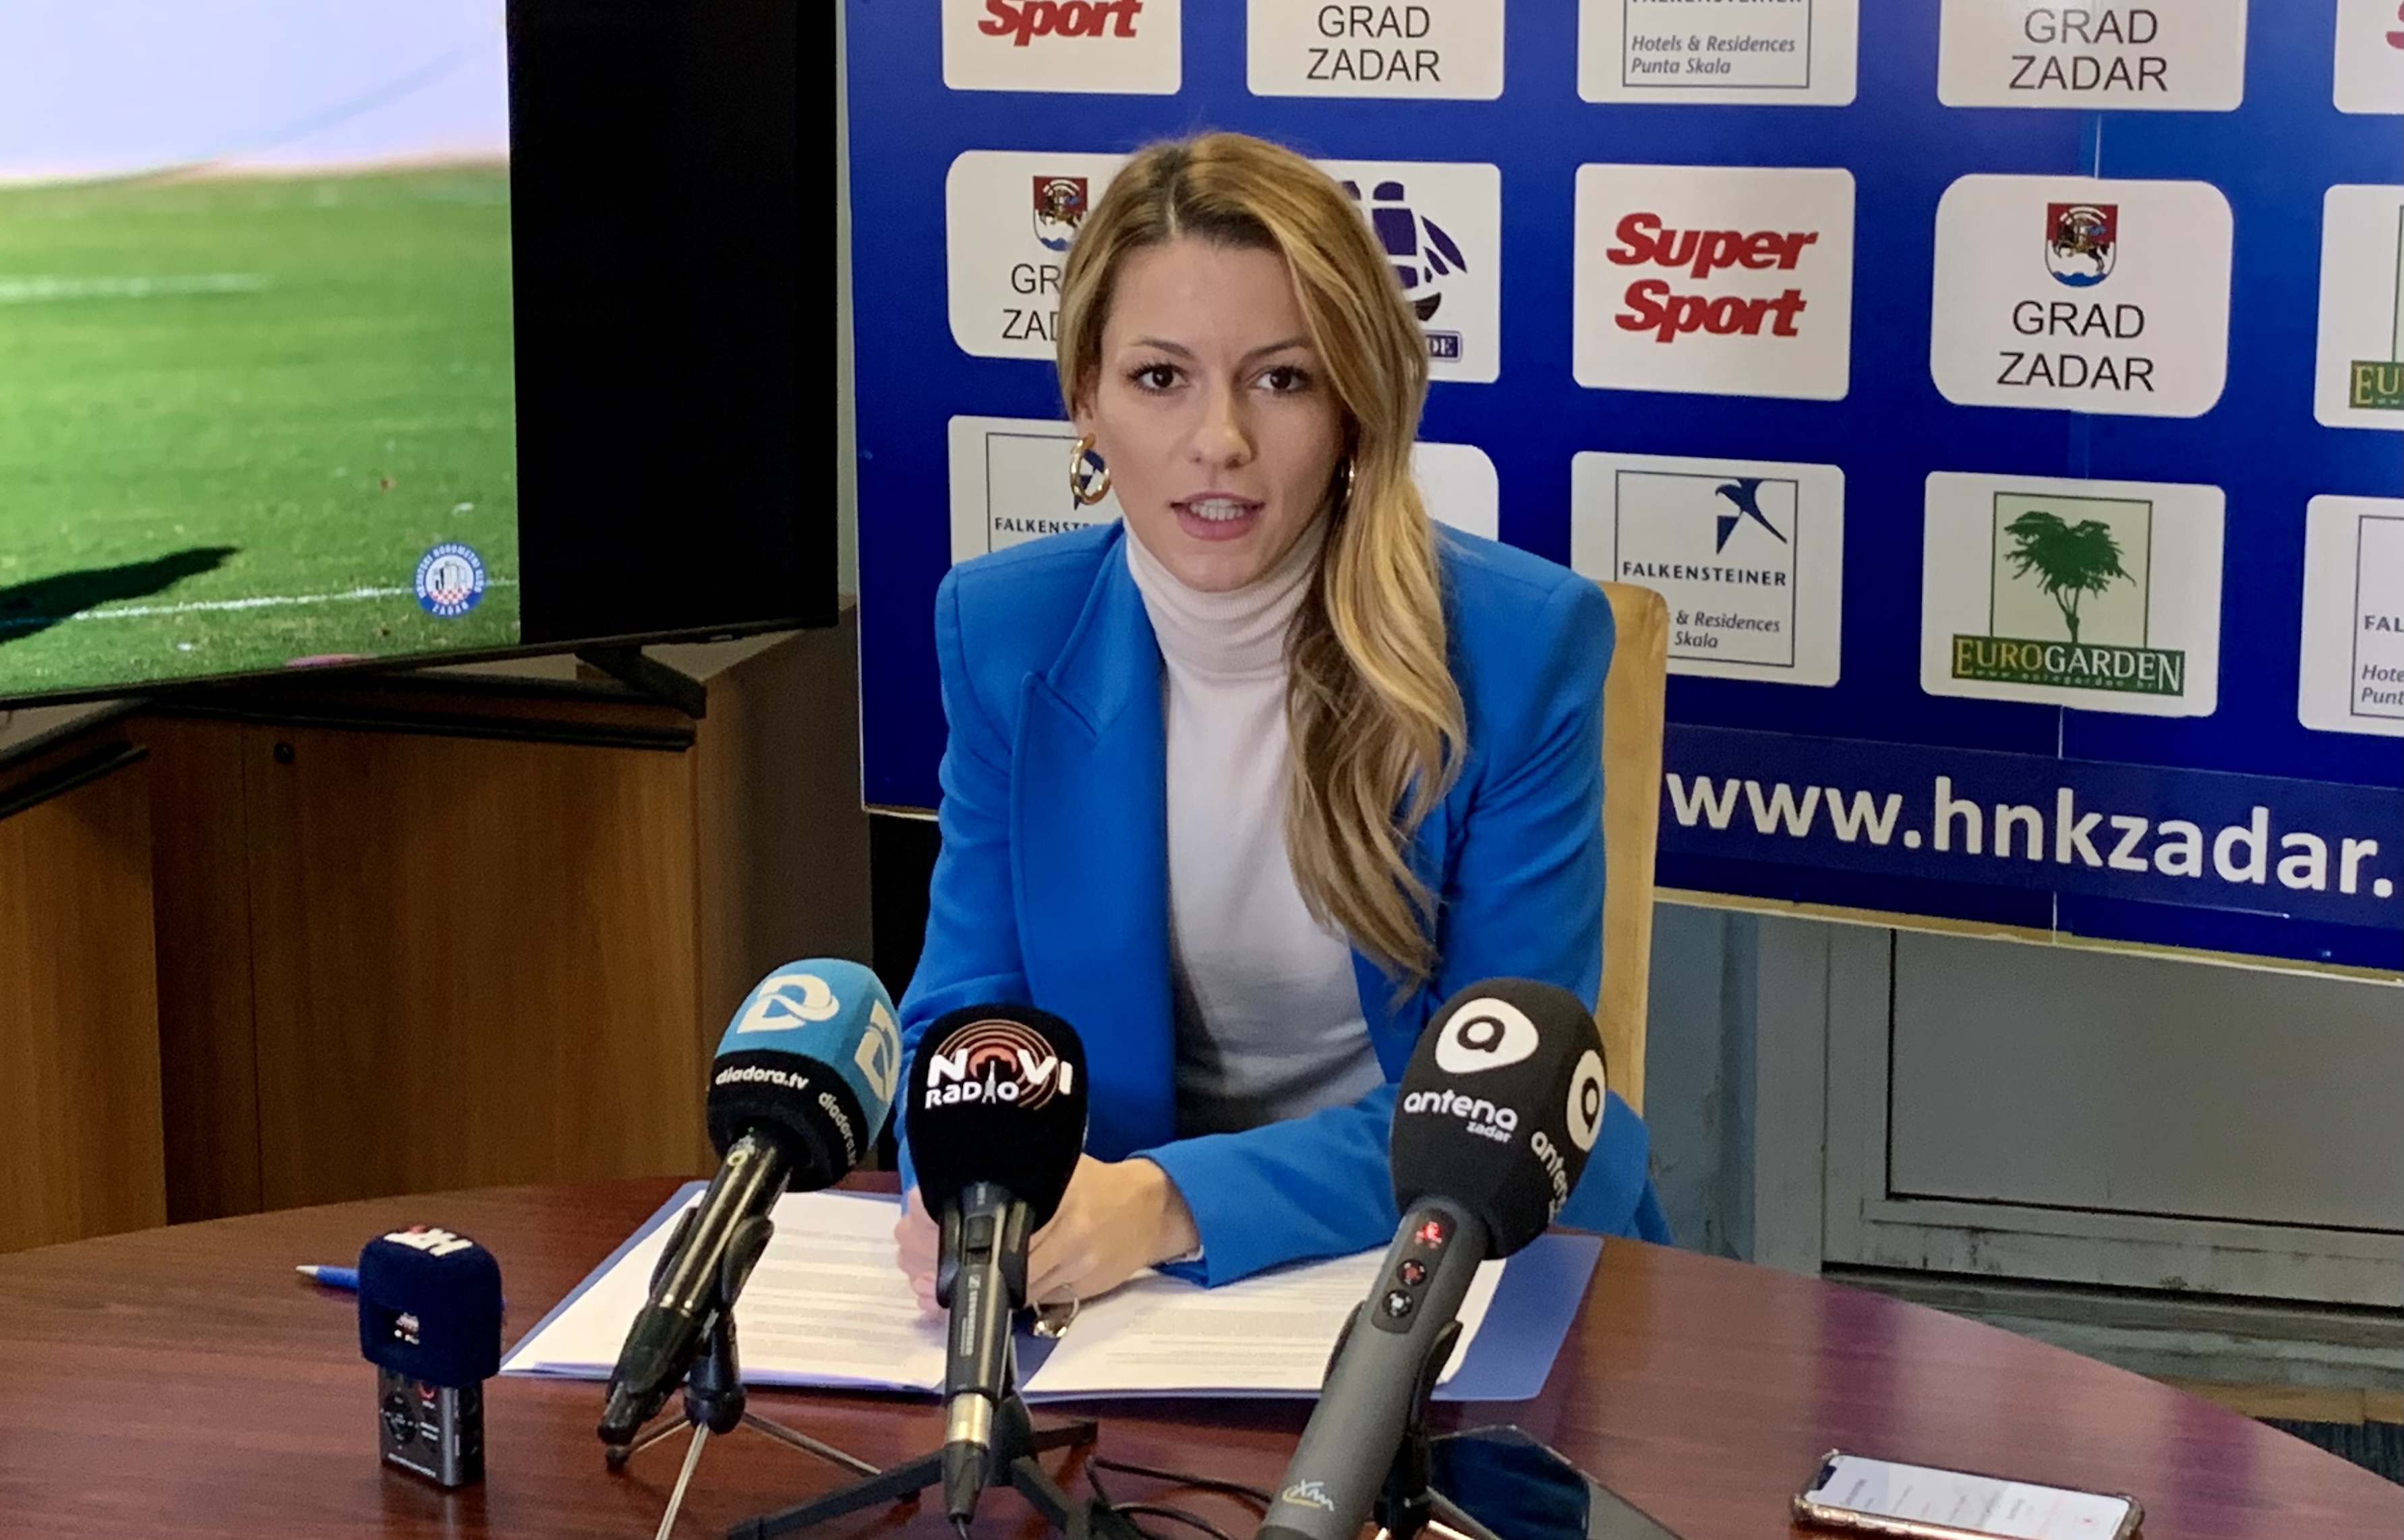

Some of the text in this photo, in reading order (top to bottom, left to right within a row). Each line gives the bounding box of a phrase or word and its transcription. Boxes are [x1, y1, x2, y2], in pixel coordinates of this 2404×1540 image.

[978, 0, 1143, 47] Sport
[1317, 5, 1431, 39] GRAD
[2024, 9, 2158, 45] GRAD
[1631, 35, 1795, 53] Hotels & Residences
[1306, 49, 1441, 82] ZADAR
[1630, 57, 1732, 75] Punta Skala
[2008, 55, 2168, 92] ZADAR
[1606, 212, 1819, 279] Super
[1614, 278, 1807, 343] Sport
[2012, 300, 2145, 338] GRAD
[1997, 351, 2154, 392] ZADAR
[995, 516, 1090, 534] FALKENST
[1622, 561, 1786, 587] FALKENSTEINER
[1676, 609, 1780, 632] & Residences
[2364, 614, 2404, 632] FAL
[1674, 630, 1719, 649] Skala
[1956, 639, 2181, 692] EUROGARDEN
[1665, 773, 2394, 898] www.hnkzadar.
[715, 1065, 809, 1090] diadora.tv
[1403, 1088, 1518, 1131] antena
[1466, 1121, 1512, 1144] zadar
